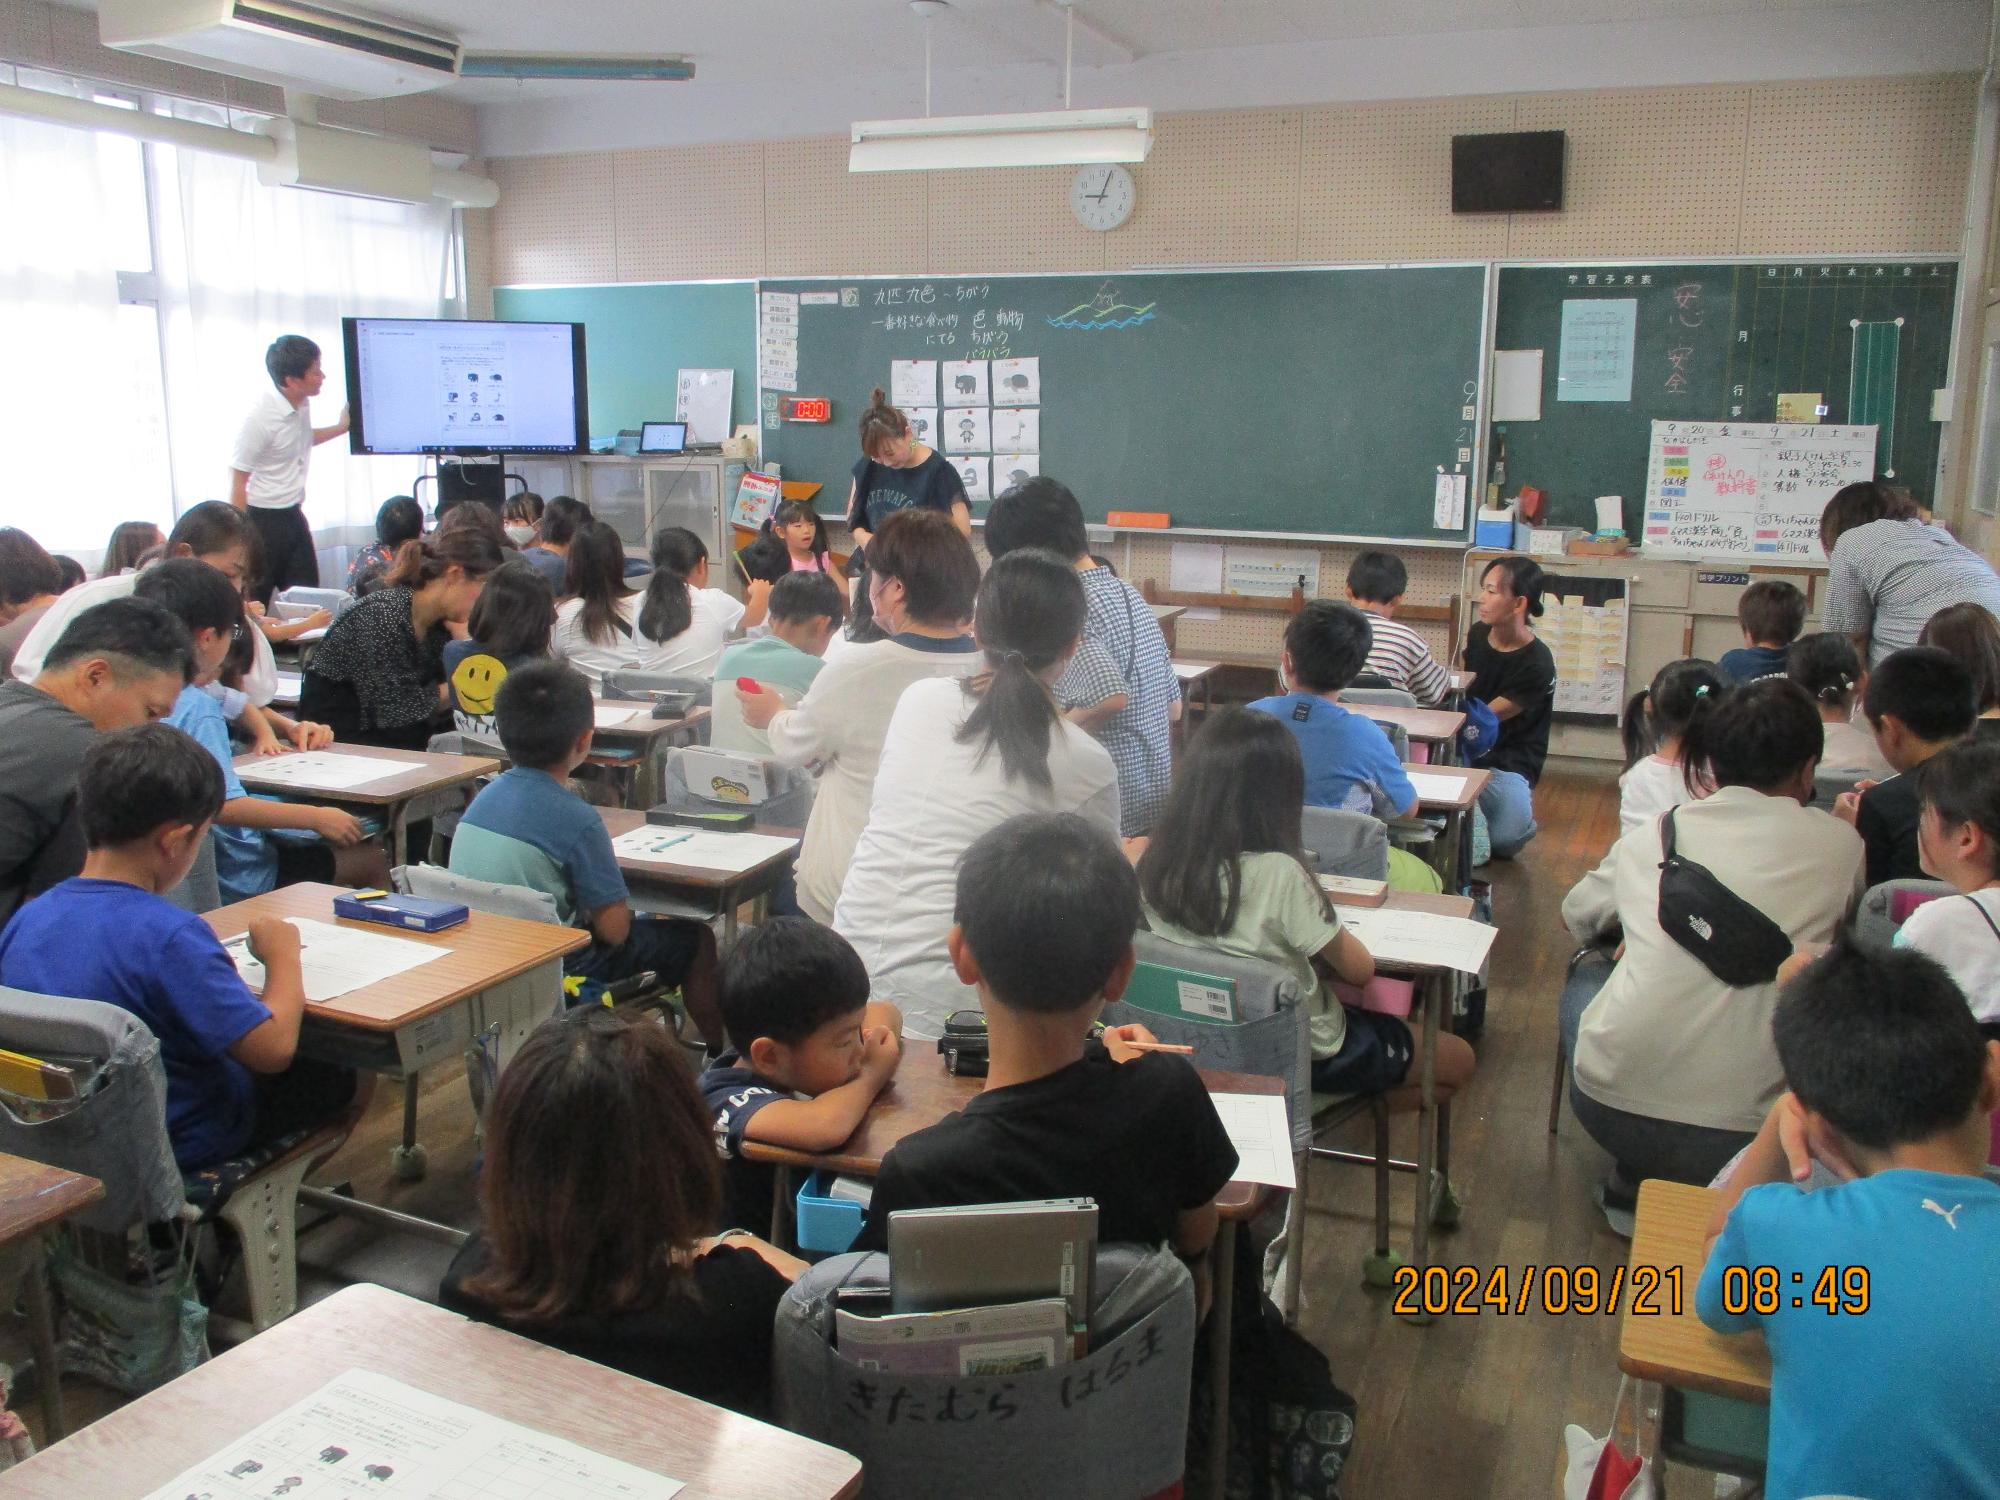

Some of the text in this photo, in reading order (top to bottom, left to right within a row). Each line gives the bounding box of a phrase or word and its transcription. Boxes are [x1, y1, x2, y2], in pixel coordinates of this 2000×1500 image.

[973, 308, 986, 329] 色
[996, 307, 1024, 331] 動物
[1463, 380, 1477, 404] 9
[797, 402, 824, 418] 0:00
[1455, 427, 1473, 444] 21
[847, 1378, 1019, 1425] きたむら
